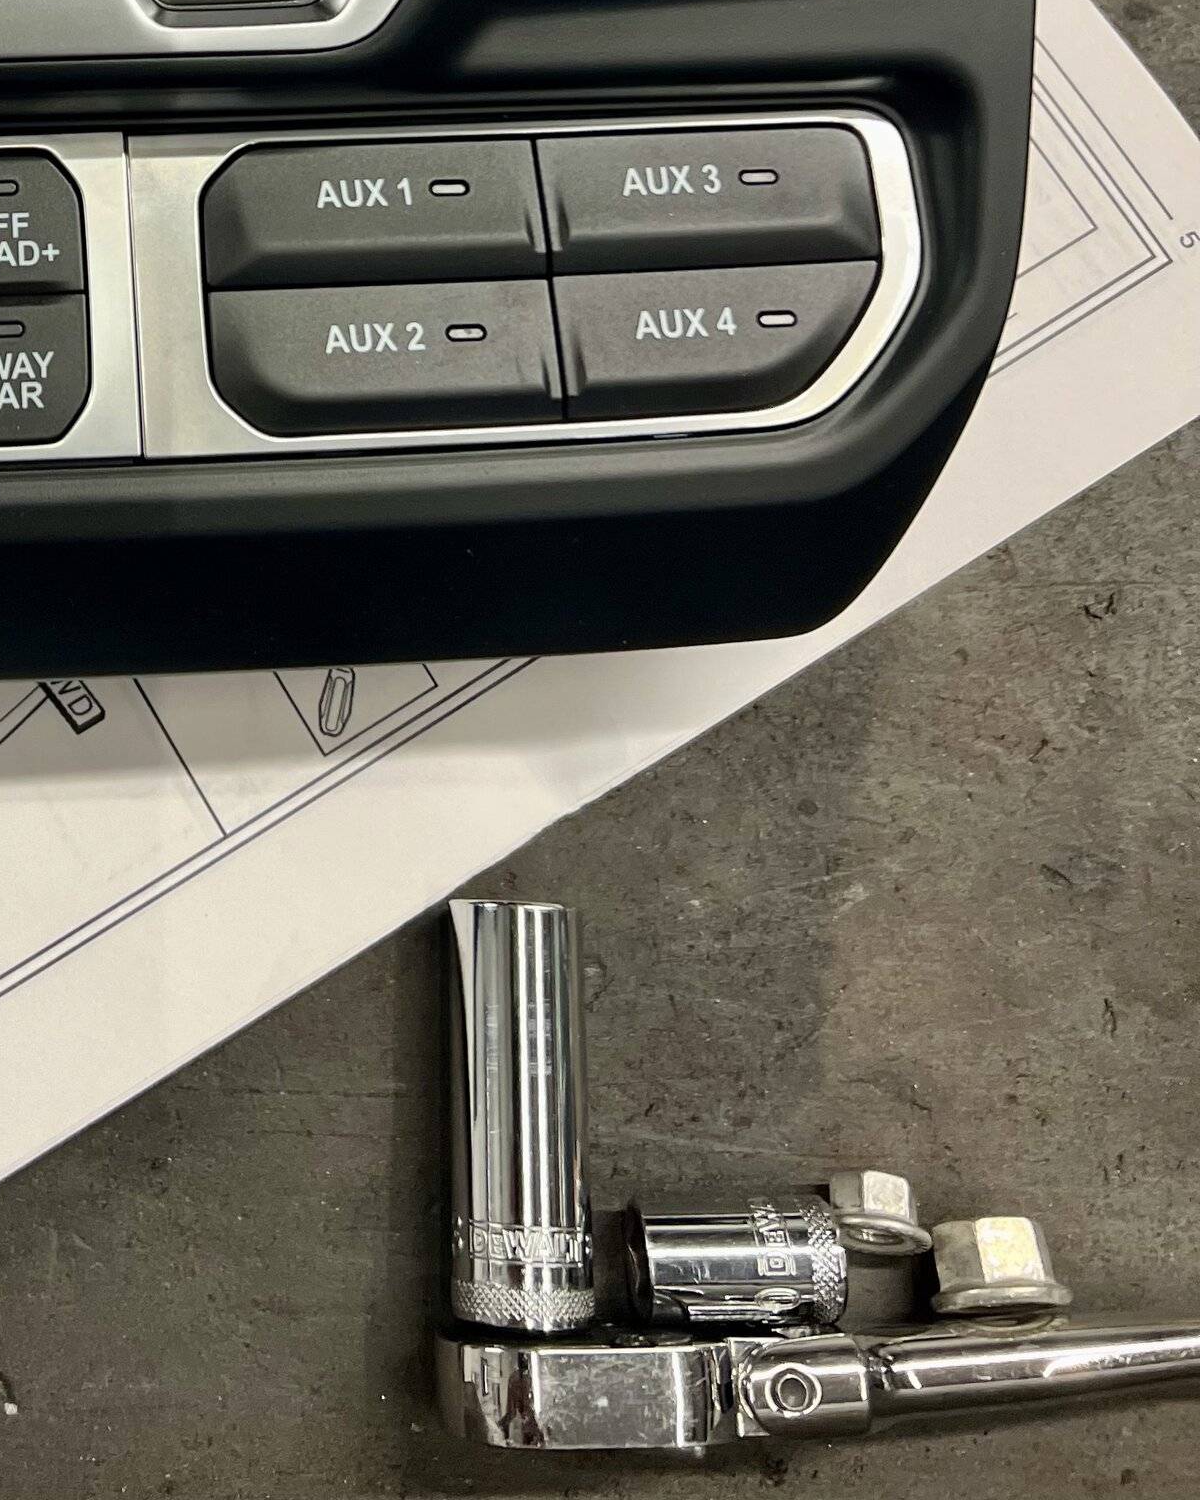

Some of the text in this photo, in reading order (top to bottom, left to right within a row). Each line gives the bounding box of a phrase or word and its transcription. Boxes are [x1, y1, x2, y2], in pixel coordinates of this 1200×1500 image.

[316, 177, 413, 210] AUX 1
[622, 164, 722, 197] AUX 3
[1180, 231, 1200, 248] 5
[325, 322, 426, 355] AUX 2
[634, 307, 737, 340] AUX 4
[50, 680, 93, 716] WD
[469, 1227, 583, 1263] DEWALT
